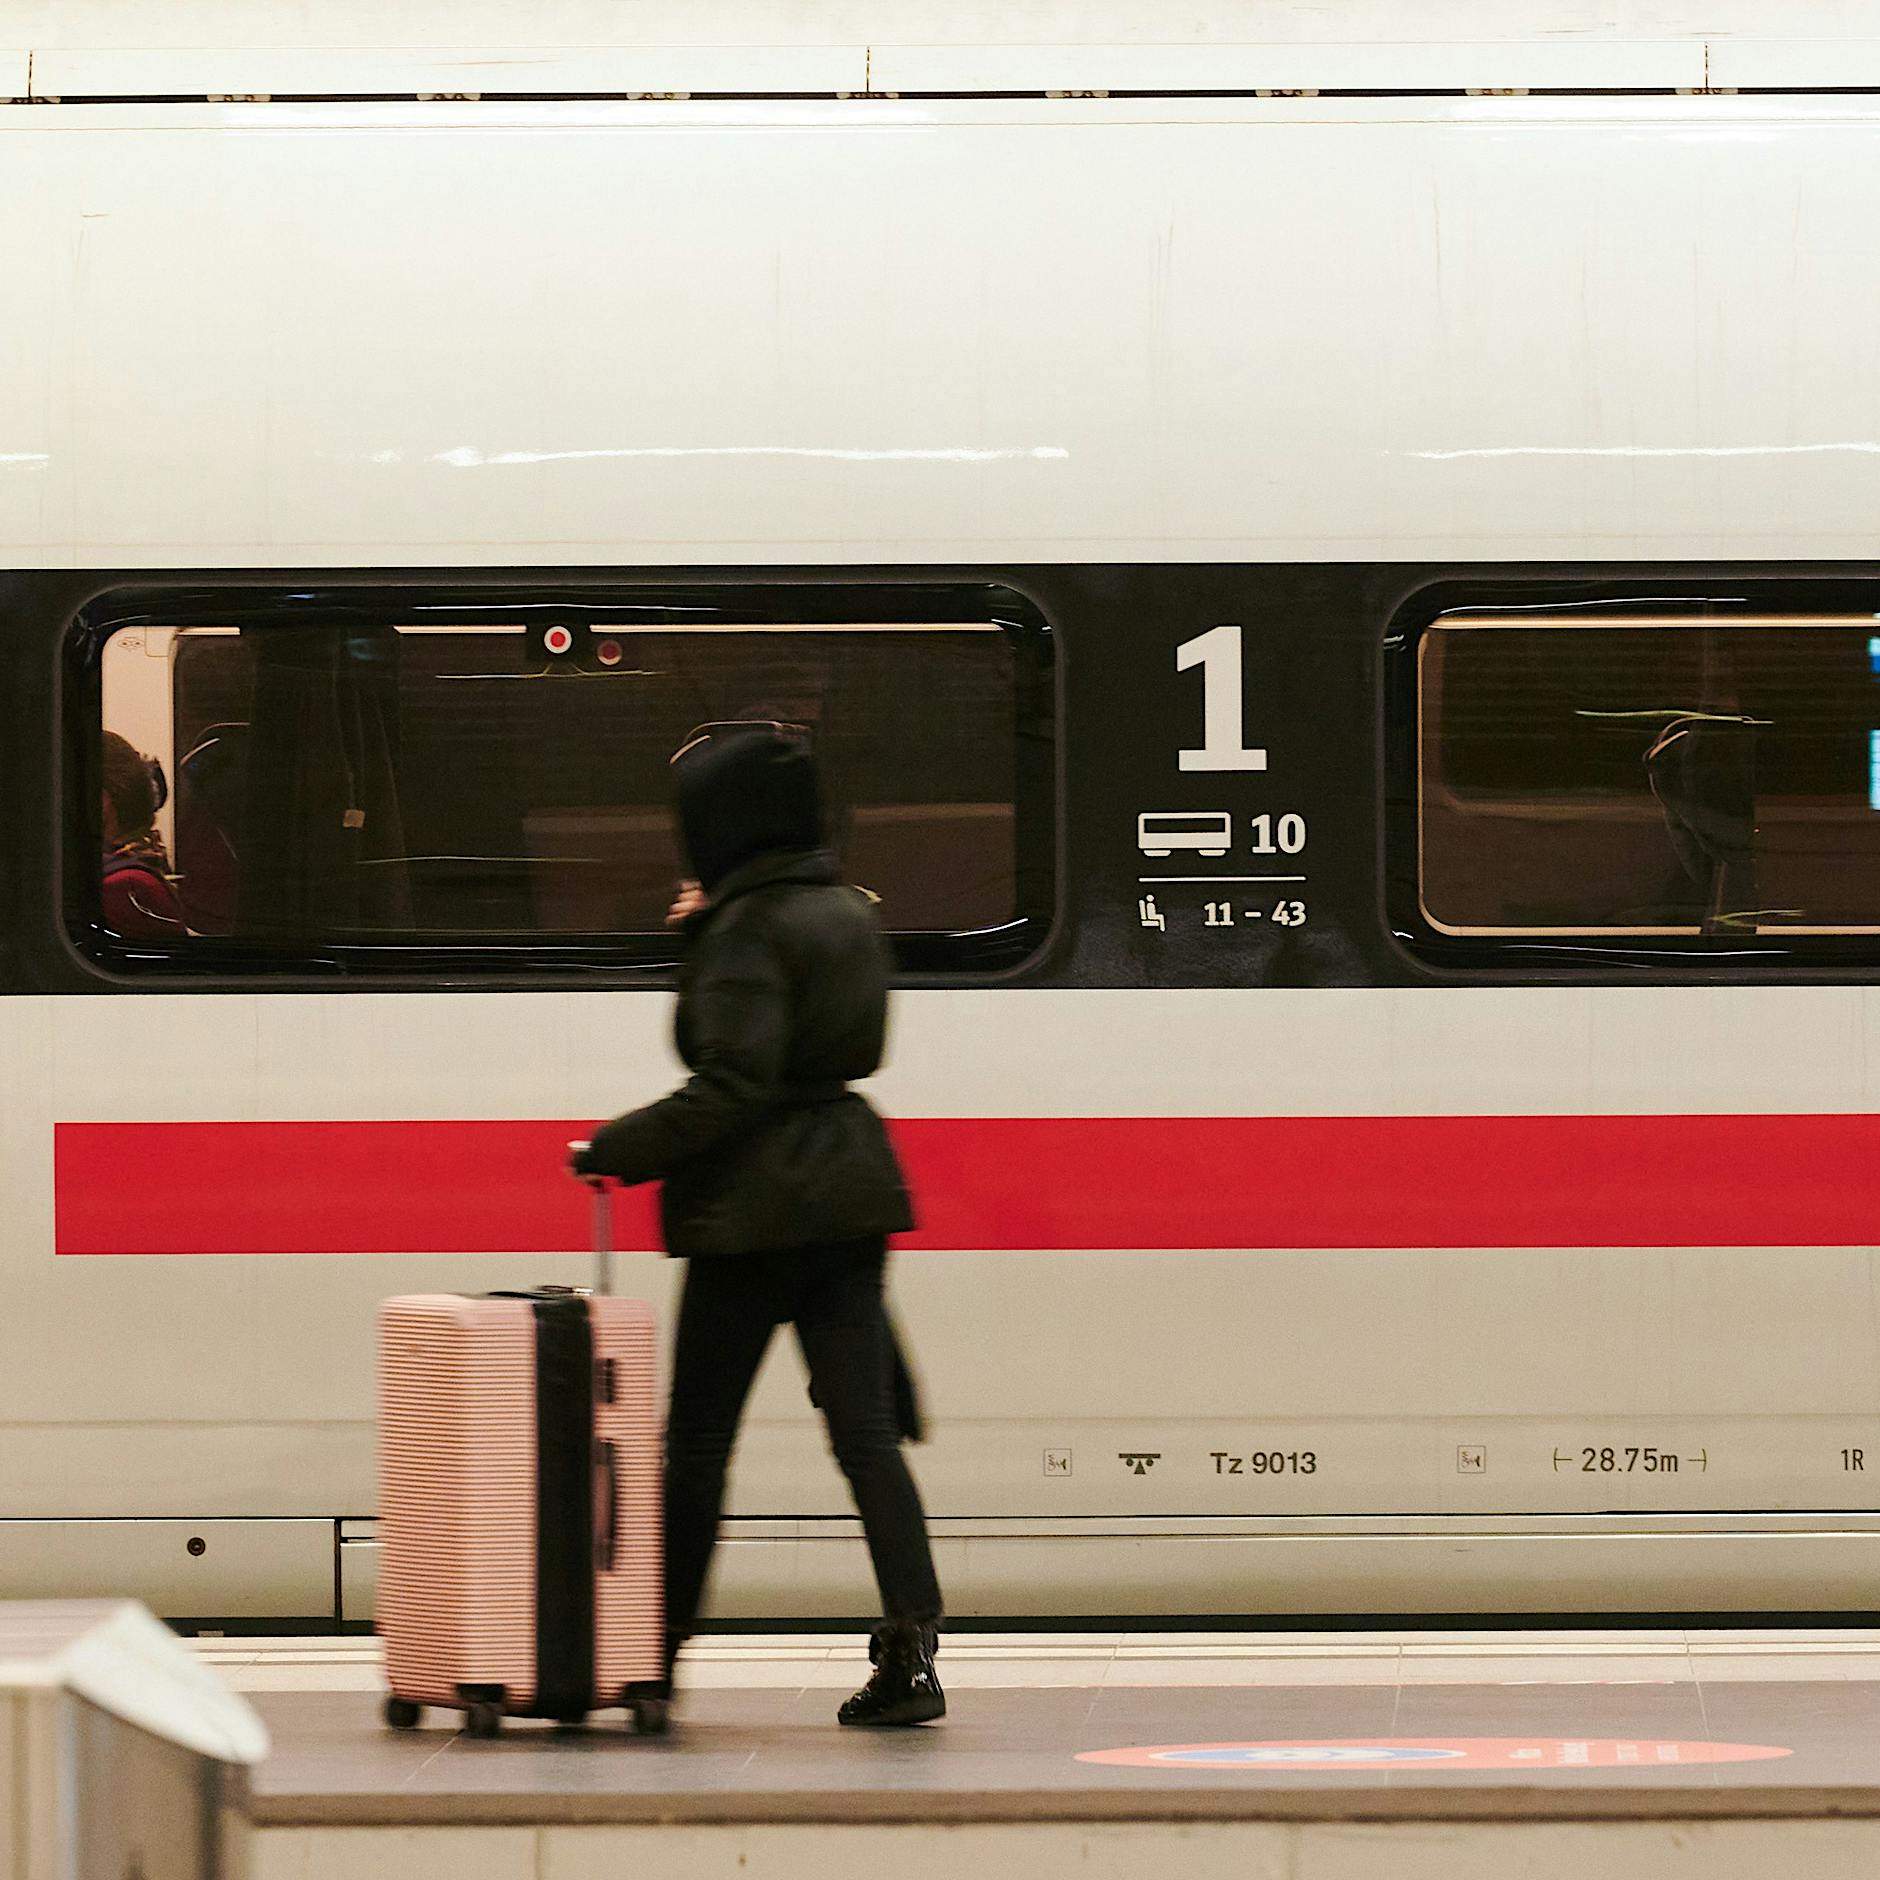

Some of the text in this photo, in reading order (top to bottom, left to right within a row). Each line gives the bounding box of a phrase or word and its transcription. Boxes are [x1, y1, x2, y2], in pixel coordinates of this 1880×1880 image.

[1176, 625, 1268, 772] 1
[1251, 813, 1306, 854] 10
[1203, 902, 1236, 927] 11
[1271, 900, 1307, 927] 43
[1209, 1451, 1318, 1475] Tz 9013
[1581, 1447, 1679, 1473] 28.75m
[1840, 1448, 1865, 1471] 1R
